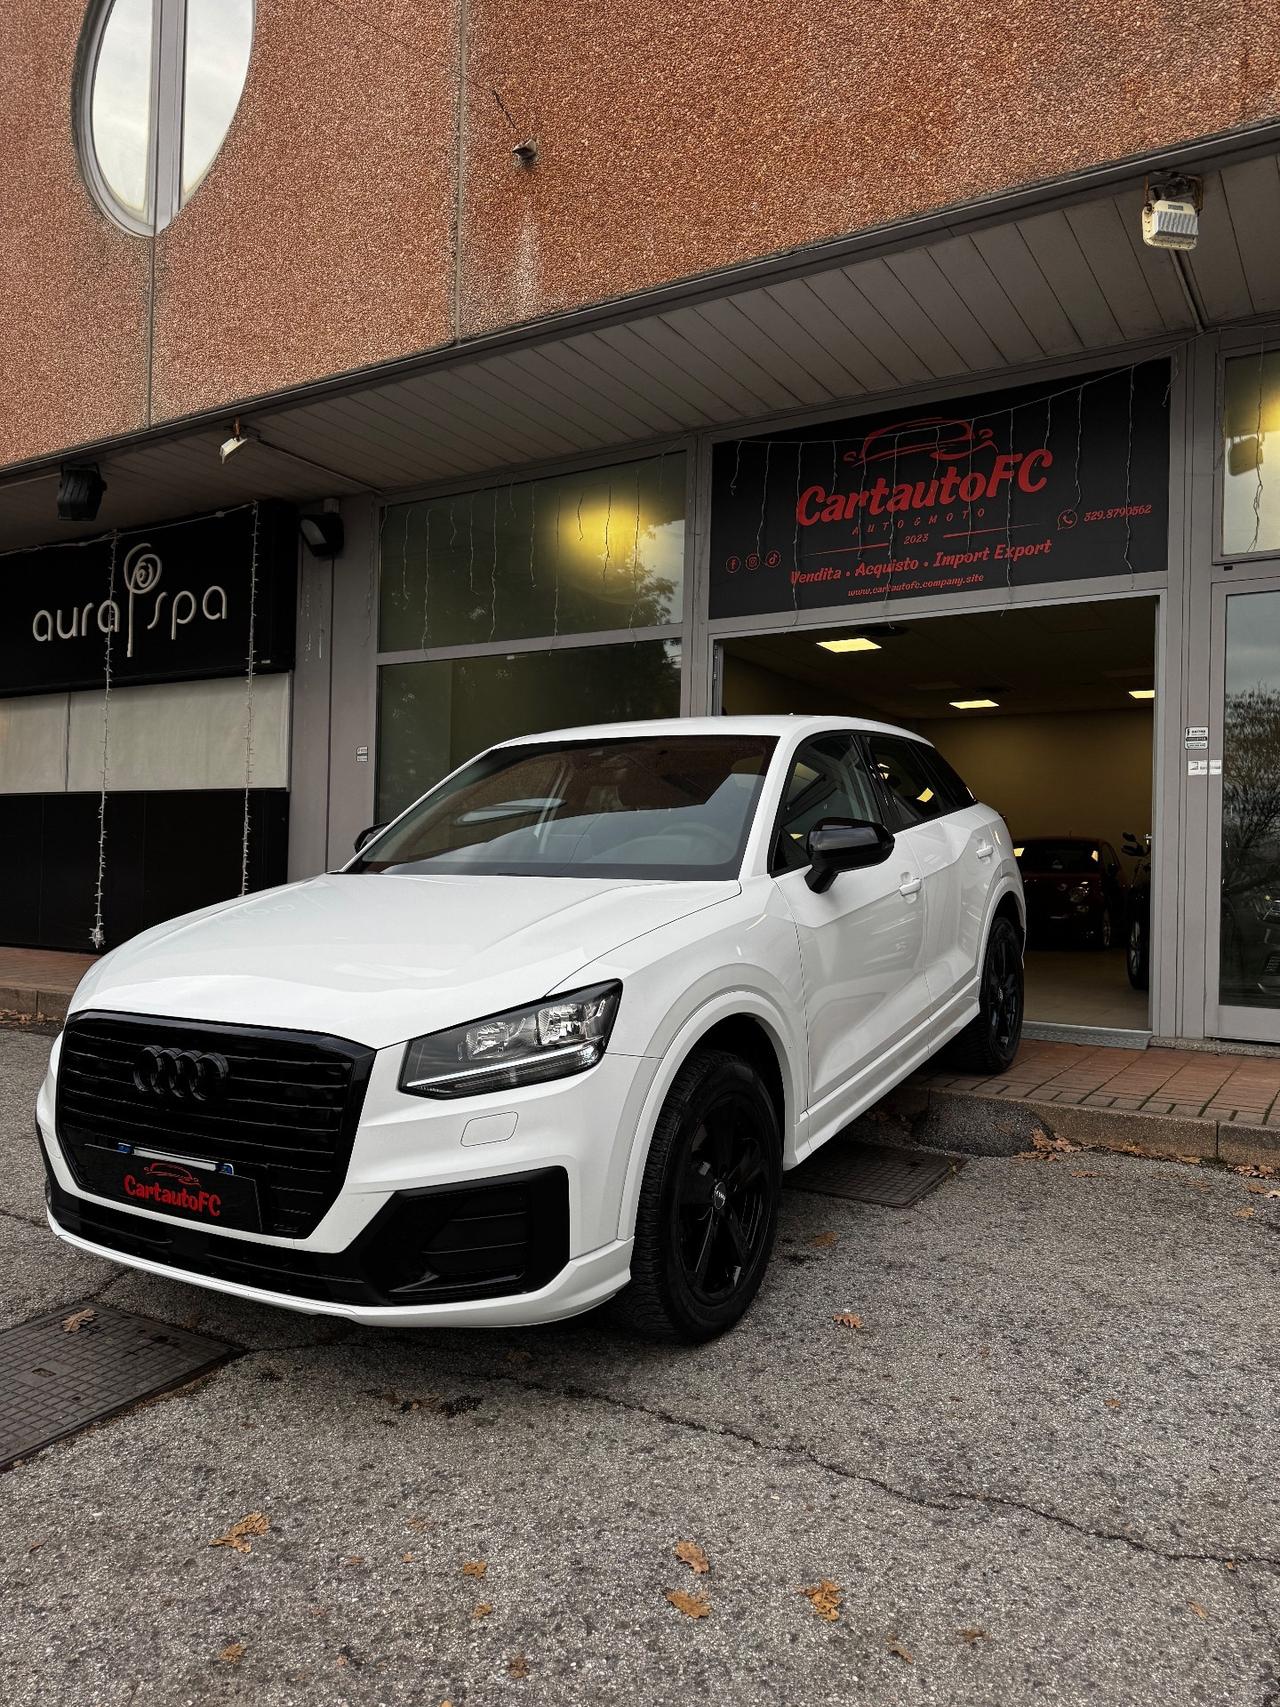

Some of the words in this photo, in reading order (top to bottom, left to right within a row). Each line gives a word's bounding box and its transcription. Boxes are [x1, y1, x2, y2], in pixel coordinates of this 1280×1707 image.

[796, 448, 1053, 526] CartautoFC
[904, 533, 929, 545] 2023
[790, 567, 842, 584] Vendita
[854, 557, 919, 579] Acquisto
[933, 547, 990, 569] Import
[994, 539, 1053, 562] Export
[847, 573, 985, 598] www.cartautofc.company.site
[32, 600, 121, 642] aura
[147, 585, 228, 641] spa
[124, 1174, 221, 1217] CartautoFC
